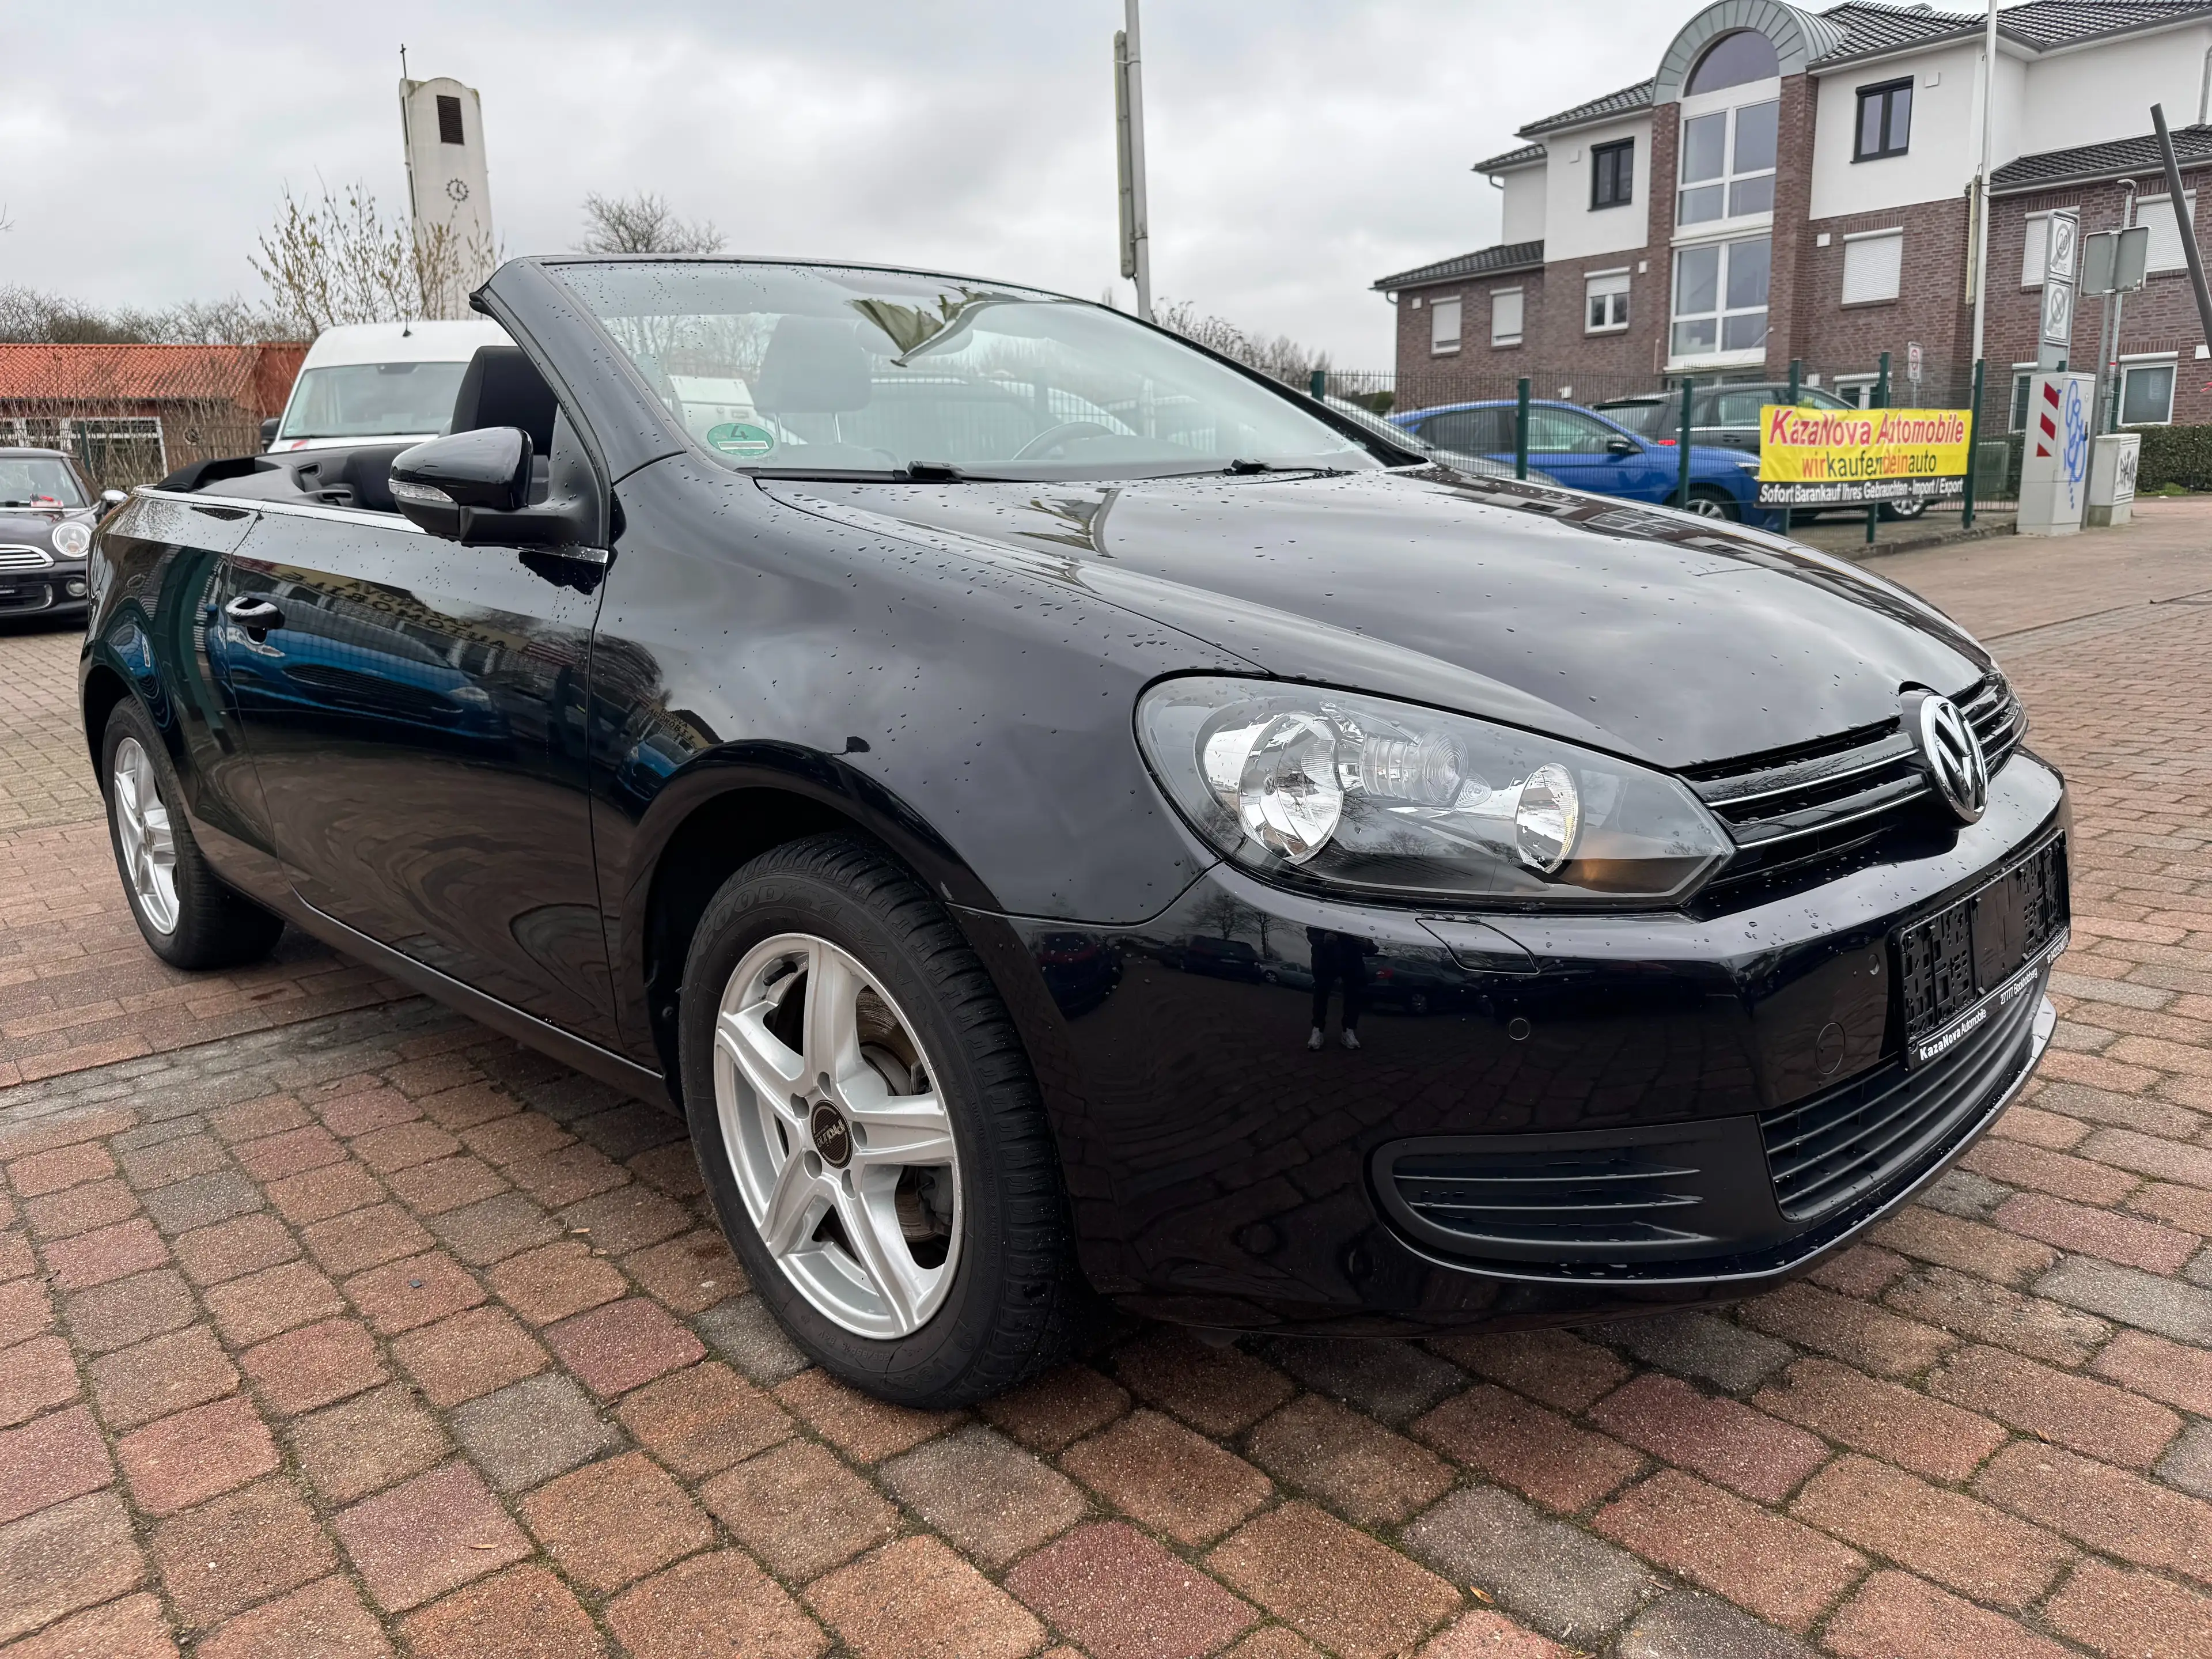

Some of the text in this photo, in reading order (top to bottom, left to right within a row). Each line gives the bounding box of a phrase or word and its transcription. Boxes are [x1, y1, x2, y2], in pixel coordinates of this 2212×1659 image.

[730, 426, 748, 440] 4
[1769, 410, 1963, 446] KazaNova Automobile
[1759, 483, 1794, 503] Sofort
[1795, 483, 1842, 502] Barankauf
[1842, 483, 1862, 500] Ihres
[1863, 479, 1908, 499] Gebrauchten
[1912, 479, 1935, 498] Import
[1940, 478, 1964, 497] Export
[2001, 986, 2013, 1005] 27777
[1919, 1009, 1986, 1060] KazaNova Automobile
